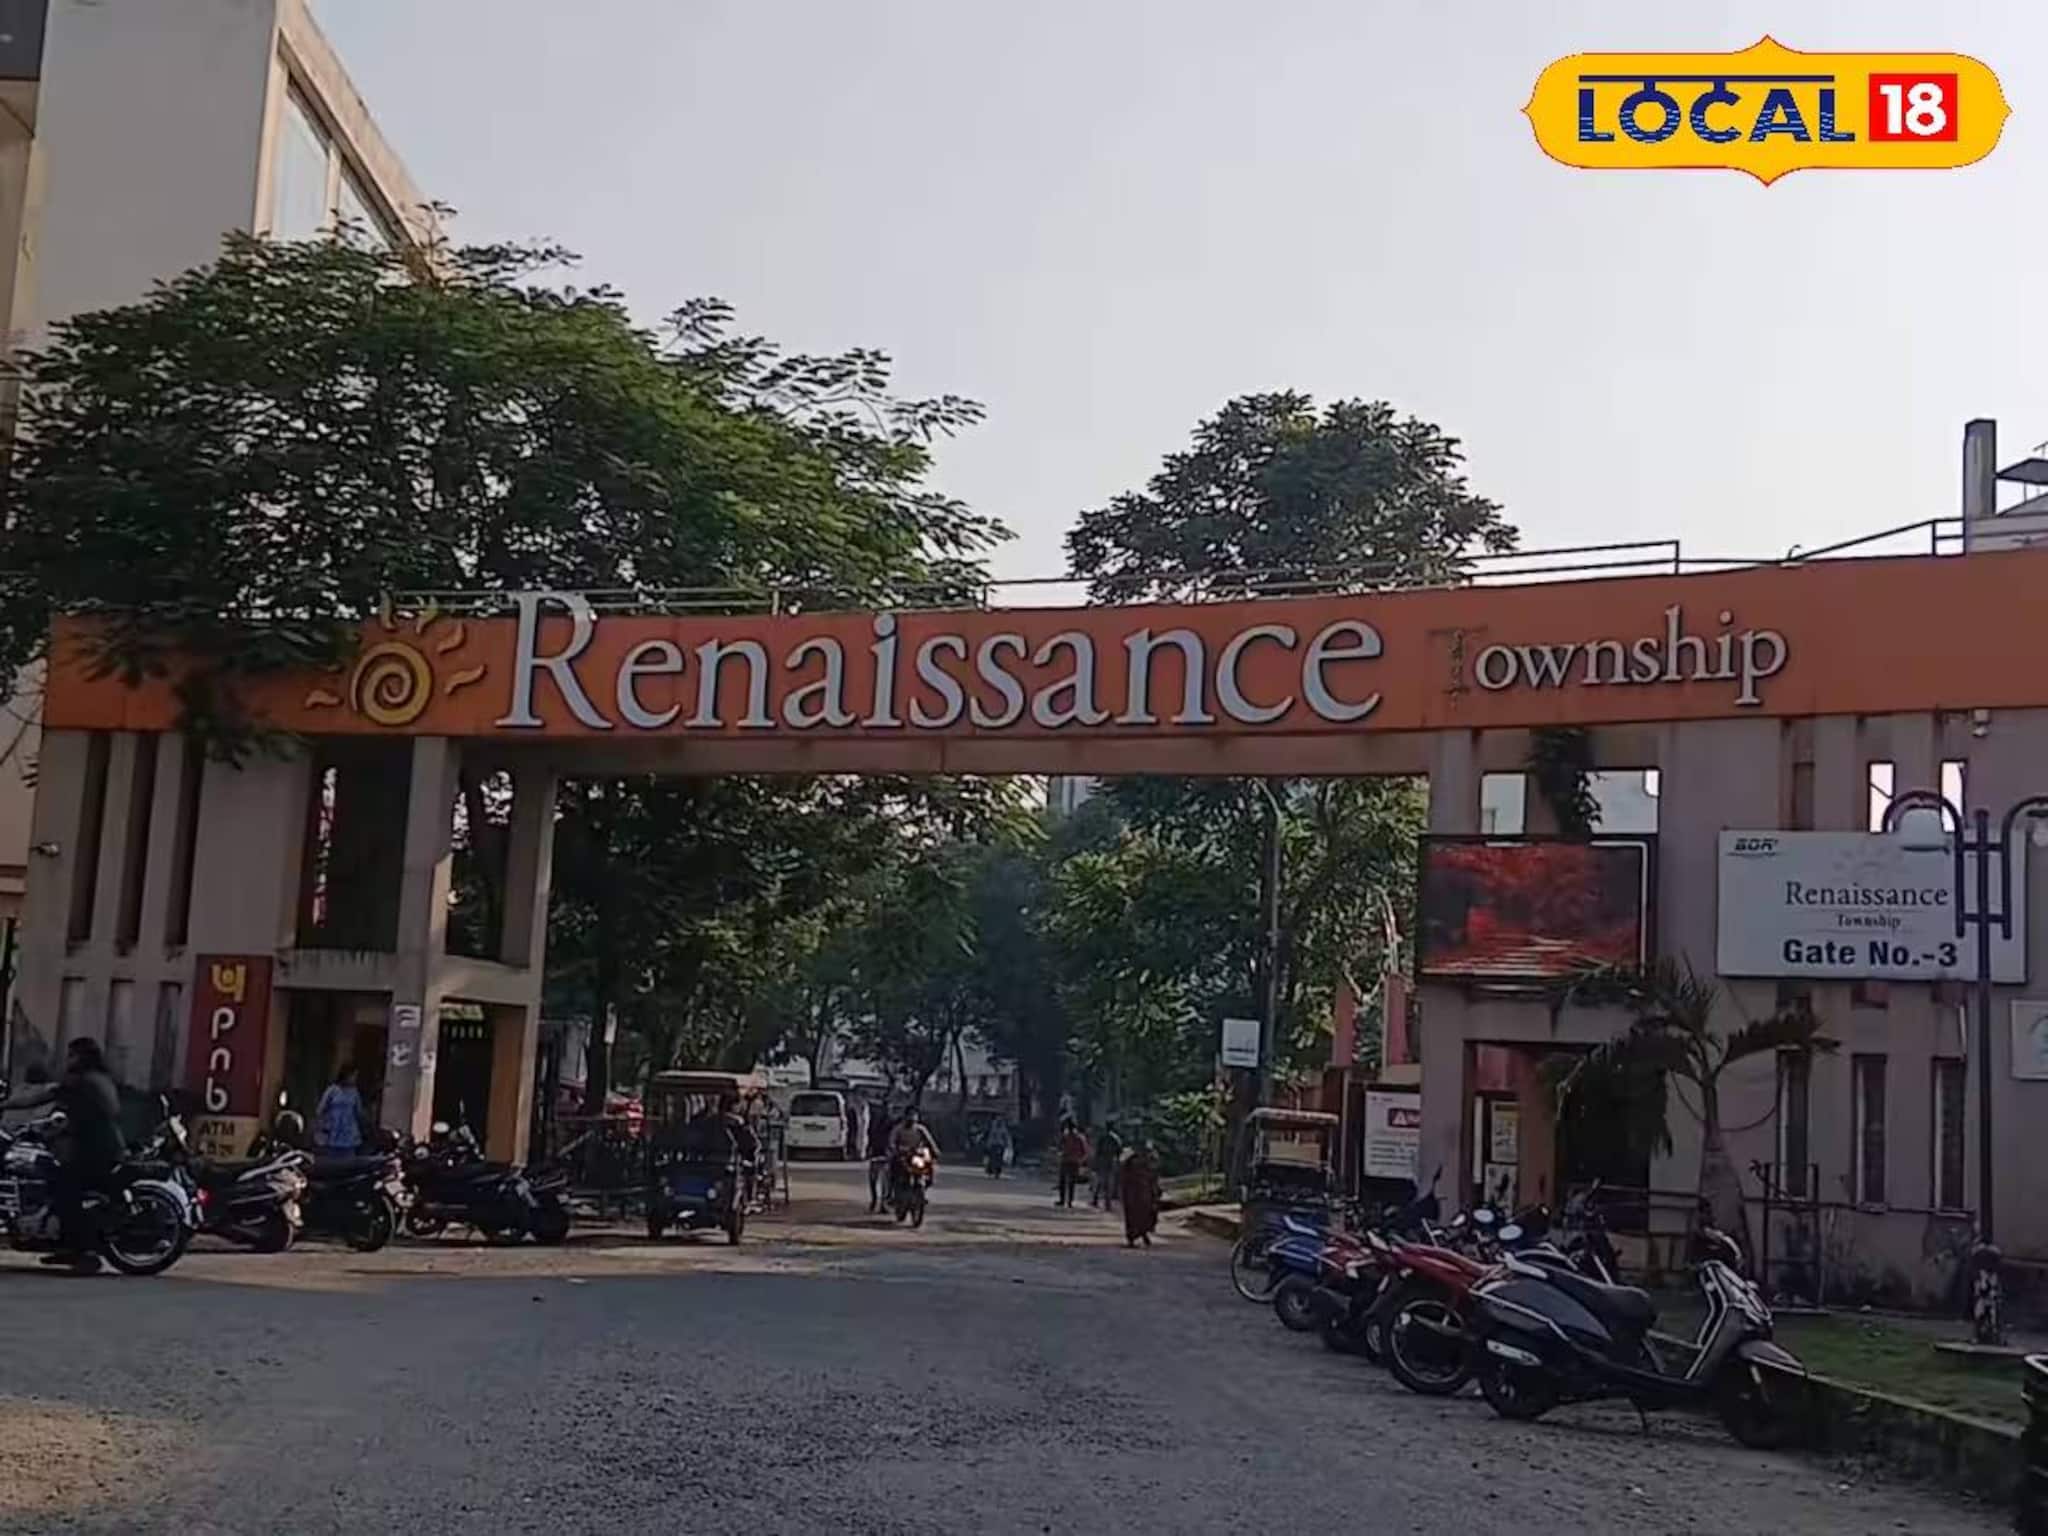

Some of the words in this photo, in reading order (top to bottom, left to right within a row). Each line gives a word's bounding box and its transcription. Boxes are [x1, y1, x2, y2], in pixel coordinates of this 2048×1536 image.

[496, 590, 1383, 731] Renaissance
[1785, 881, 1949, 906] Renaissance
[1838, 913, 1901, 929] Township
[1783, 938, 1856, 964] Gate
[1869, 940, 1958, 967] No.-3
[205, 1007, 236, 1113] pnb
[199, 1120, 235, 1136] ATM
